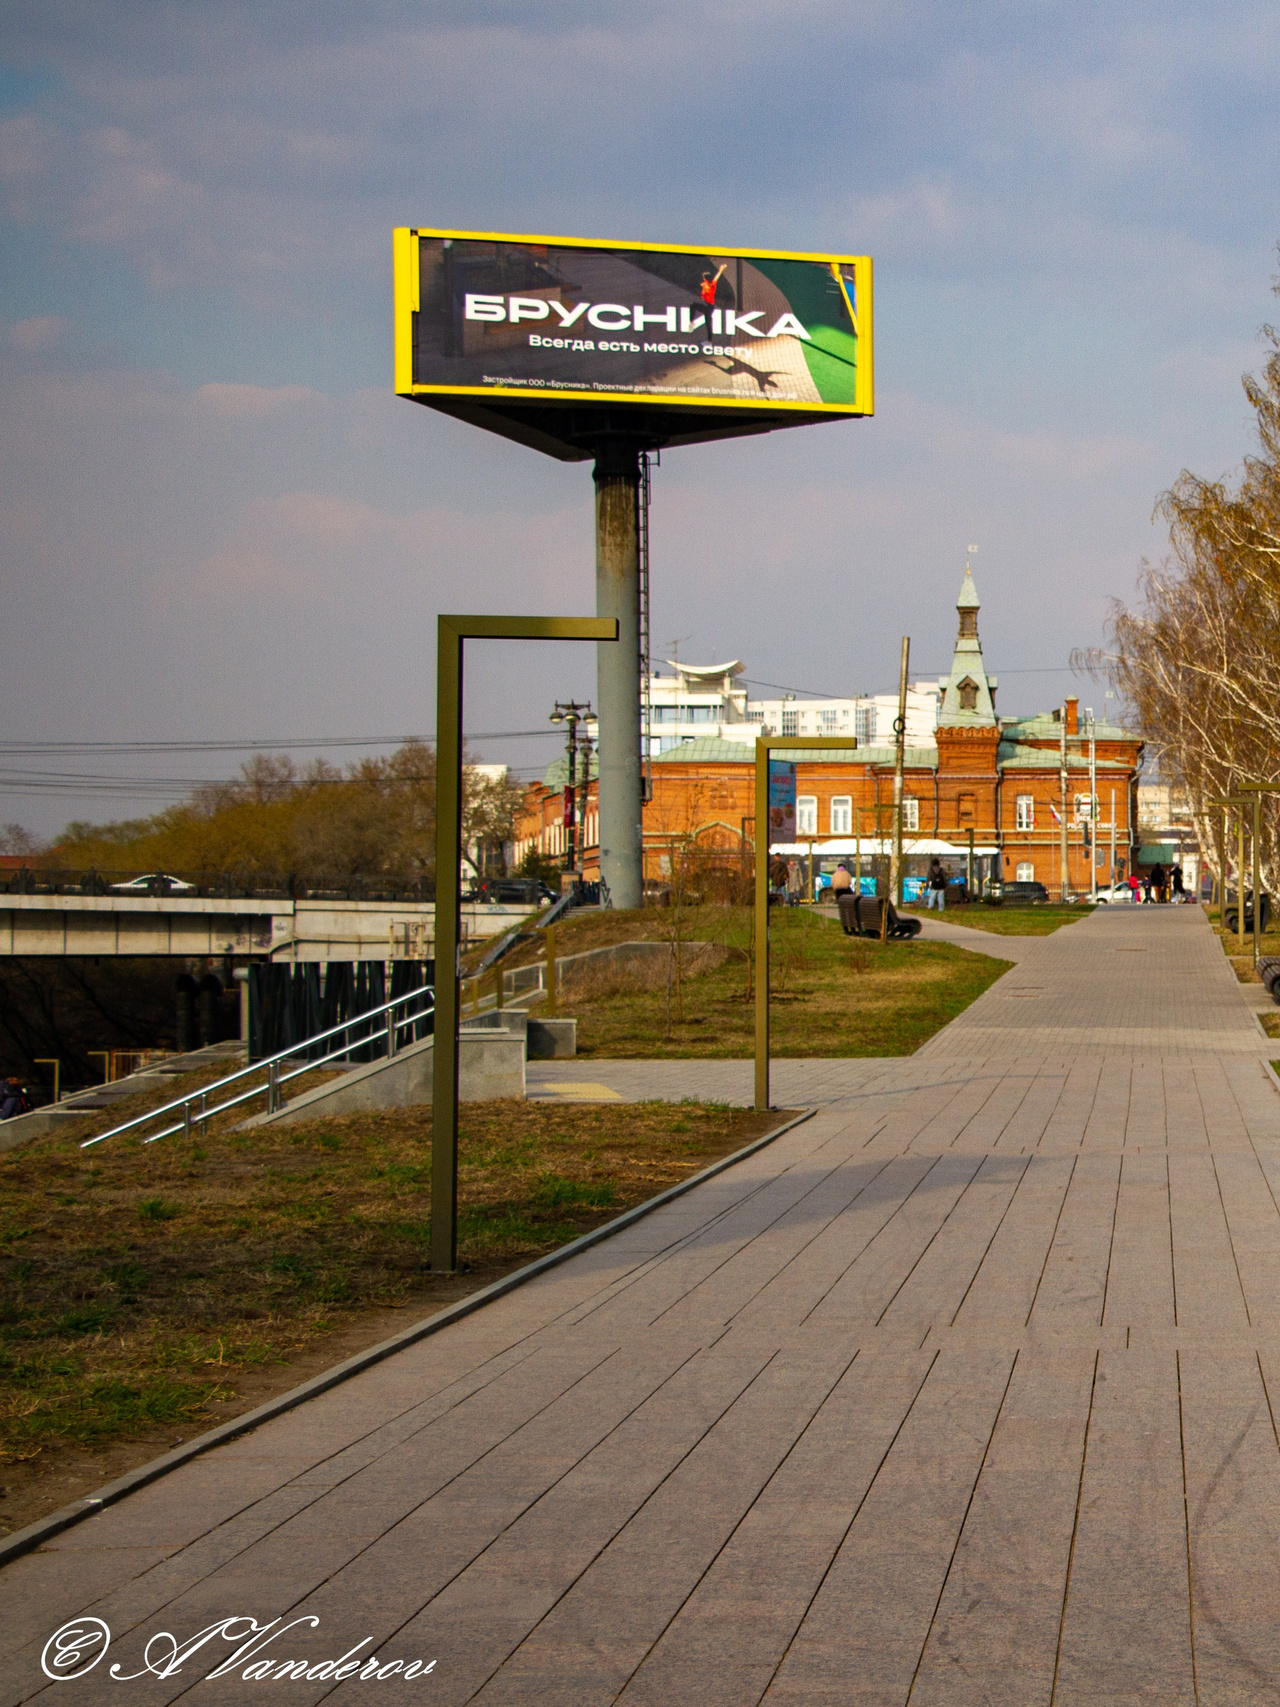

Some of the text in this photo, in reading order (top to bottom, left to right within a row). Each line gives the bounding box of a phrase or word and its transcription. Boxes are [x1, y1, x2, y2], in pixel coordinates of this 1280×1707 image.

[465, 293, 812, 340] БРУСНИКА
[528, 334, 754, 359] Всегда есть место свету
[528, 378, 546, 387] ООО
